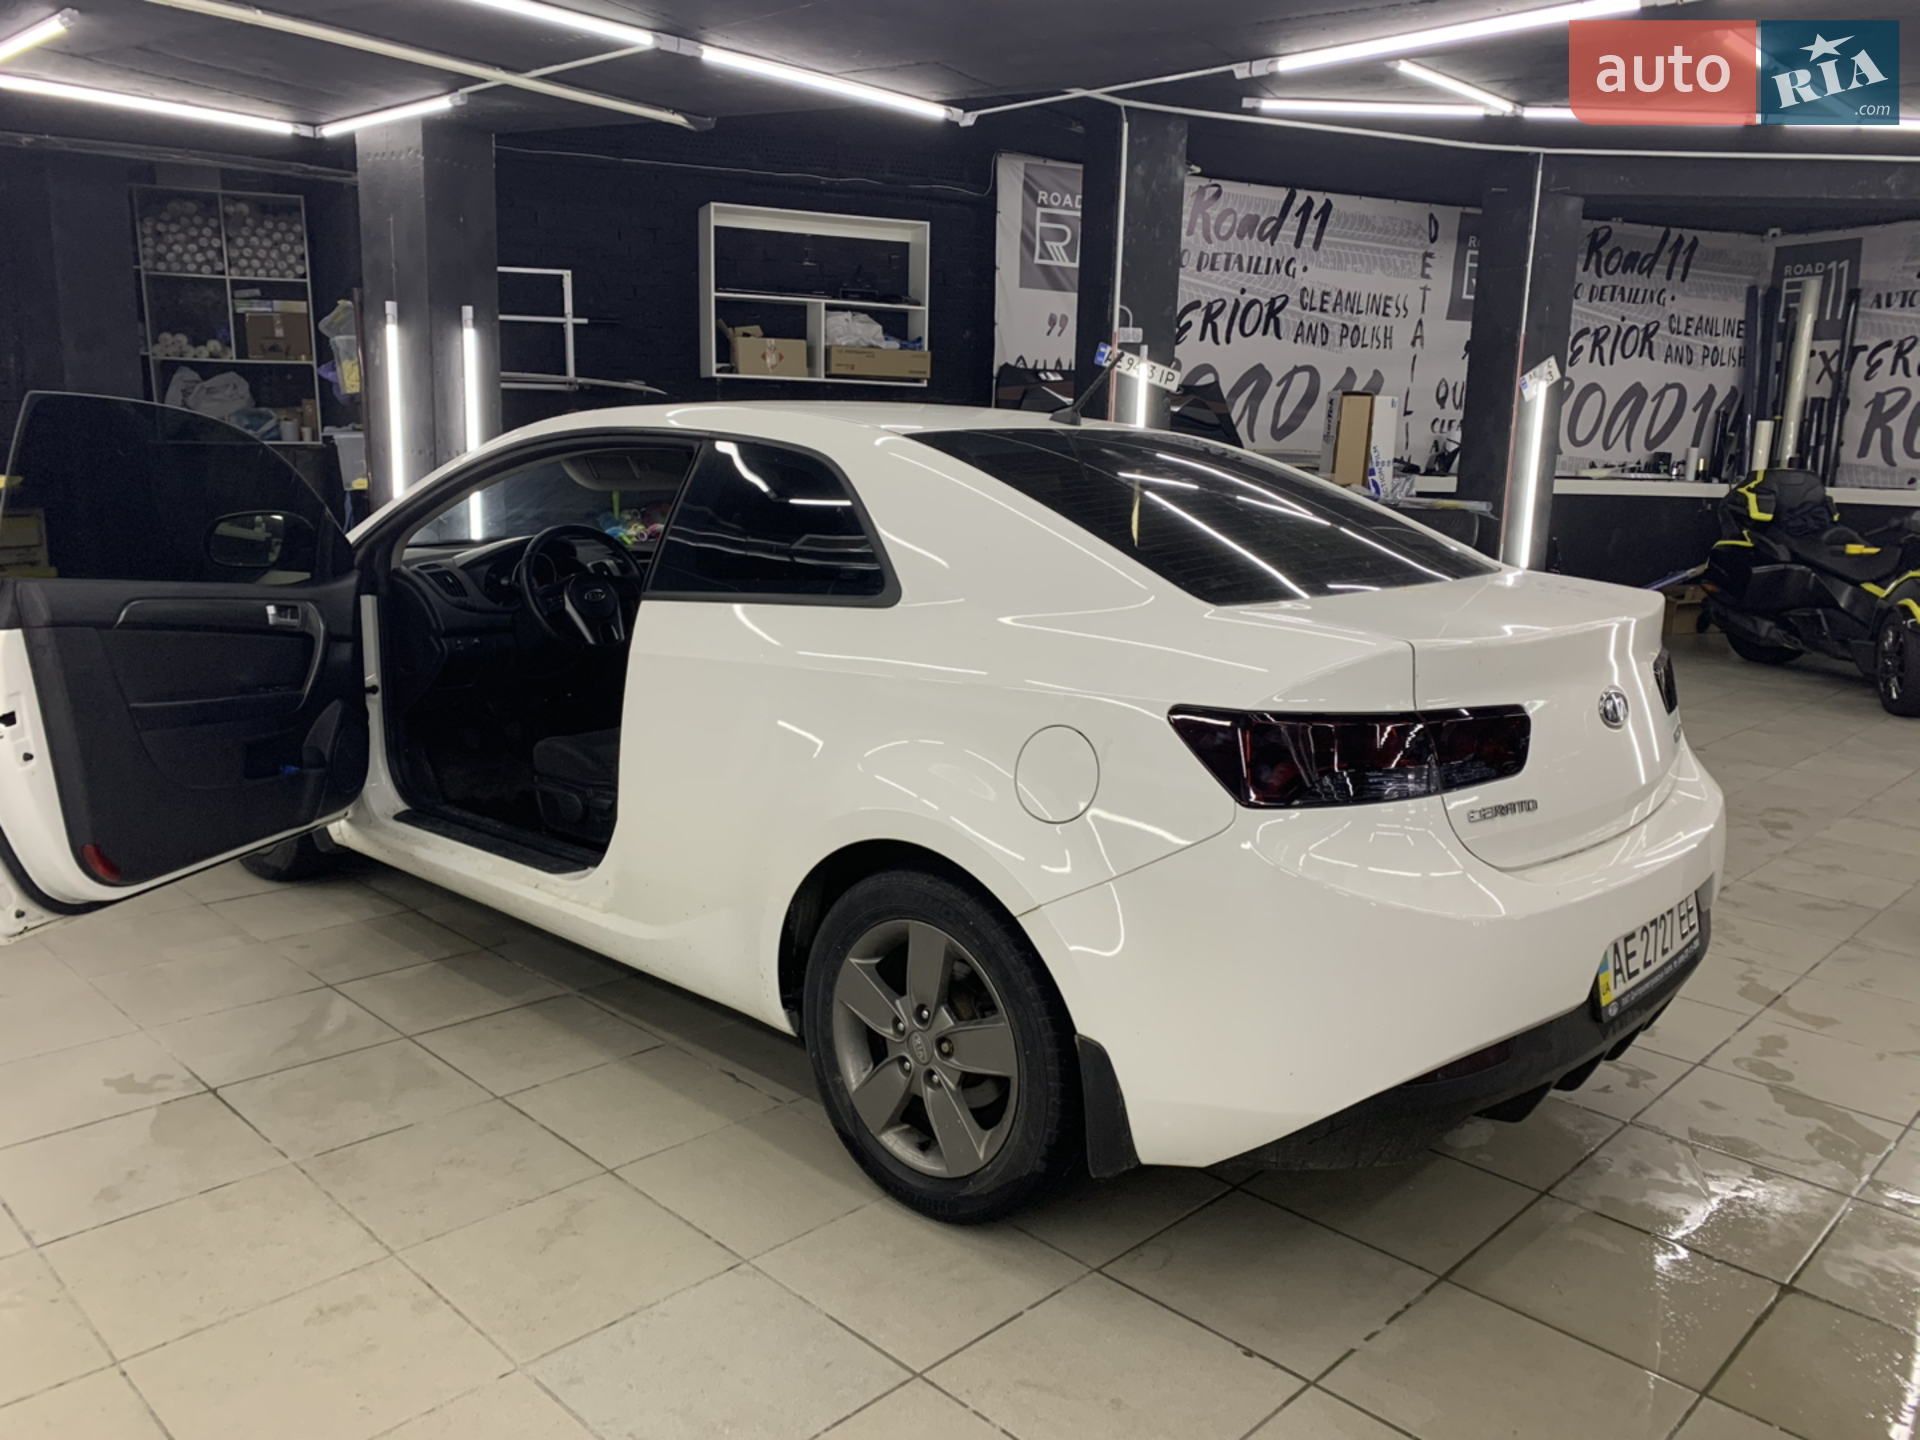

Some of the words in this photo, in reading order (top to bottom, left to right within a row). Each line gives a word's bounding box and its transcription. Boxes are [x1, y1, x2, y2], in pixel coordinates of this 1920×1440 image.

[1784, 262, 1826, 277] ROAD
[1300, 287, 1410, 318] CLEANLINESS
[1294, 321, 1329, 347] AND
[1339, 322, 1394, 350] POLISH
[1664, 343, 1693, 366] AND
[1612, 931, 1640, 990] AE
[1640, 907, 1675, 971] 2727
[1677, 891, 1697, 941] EE
